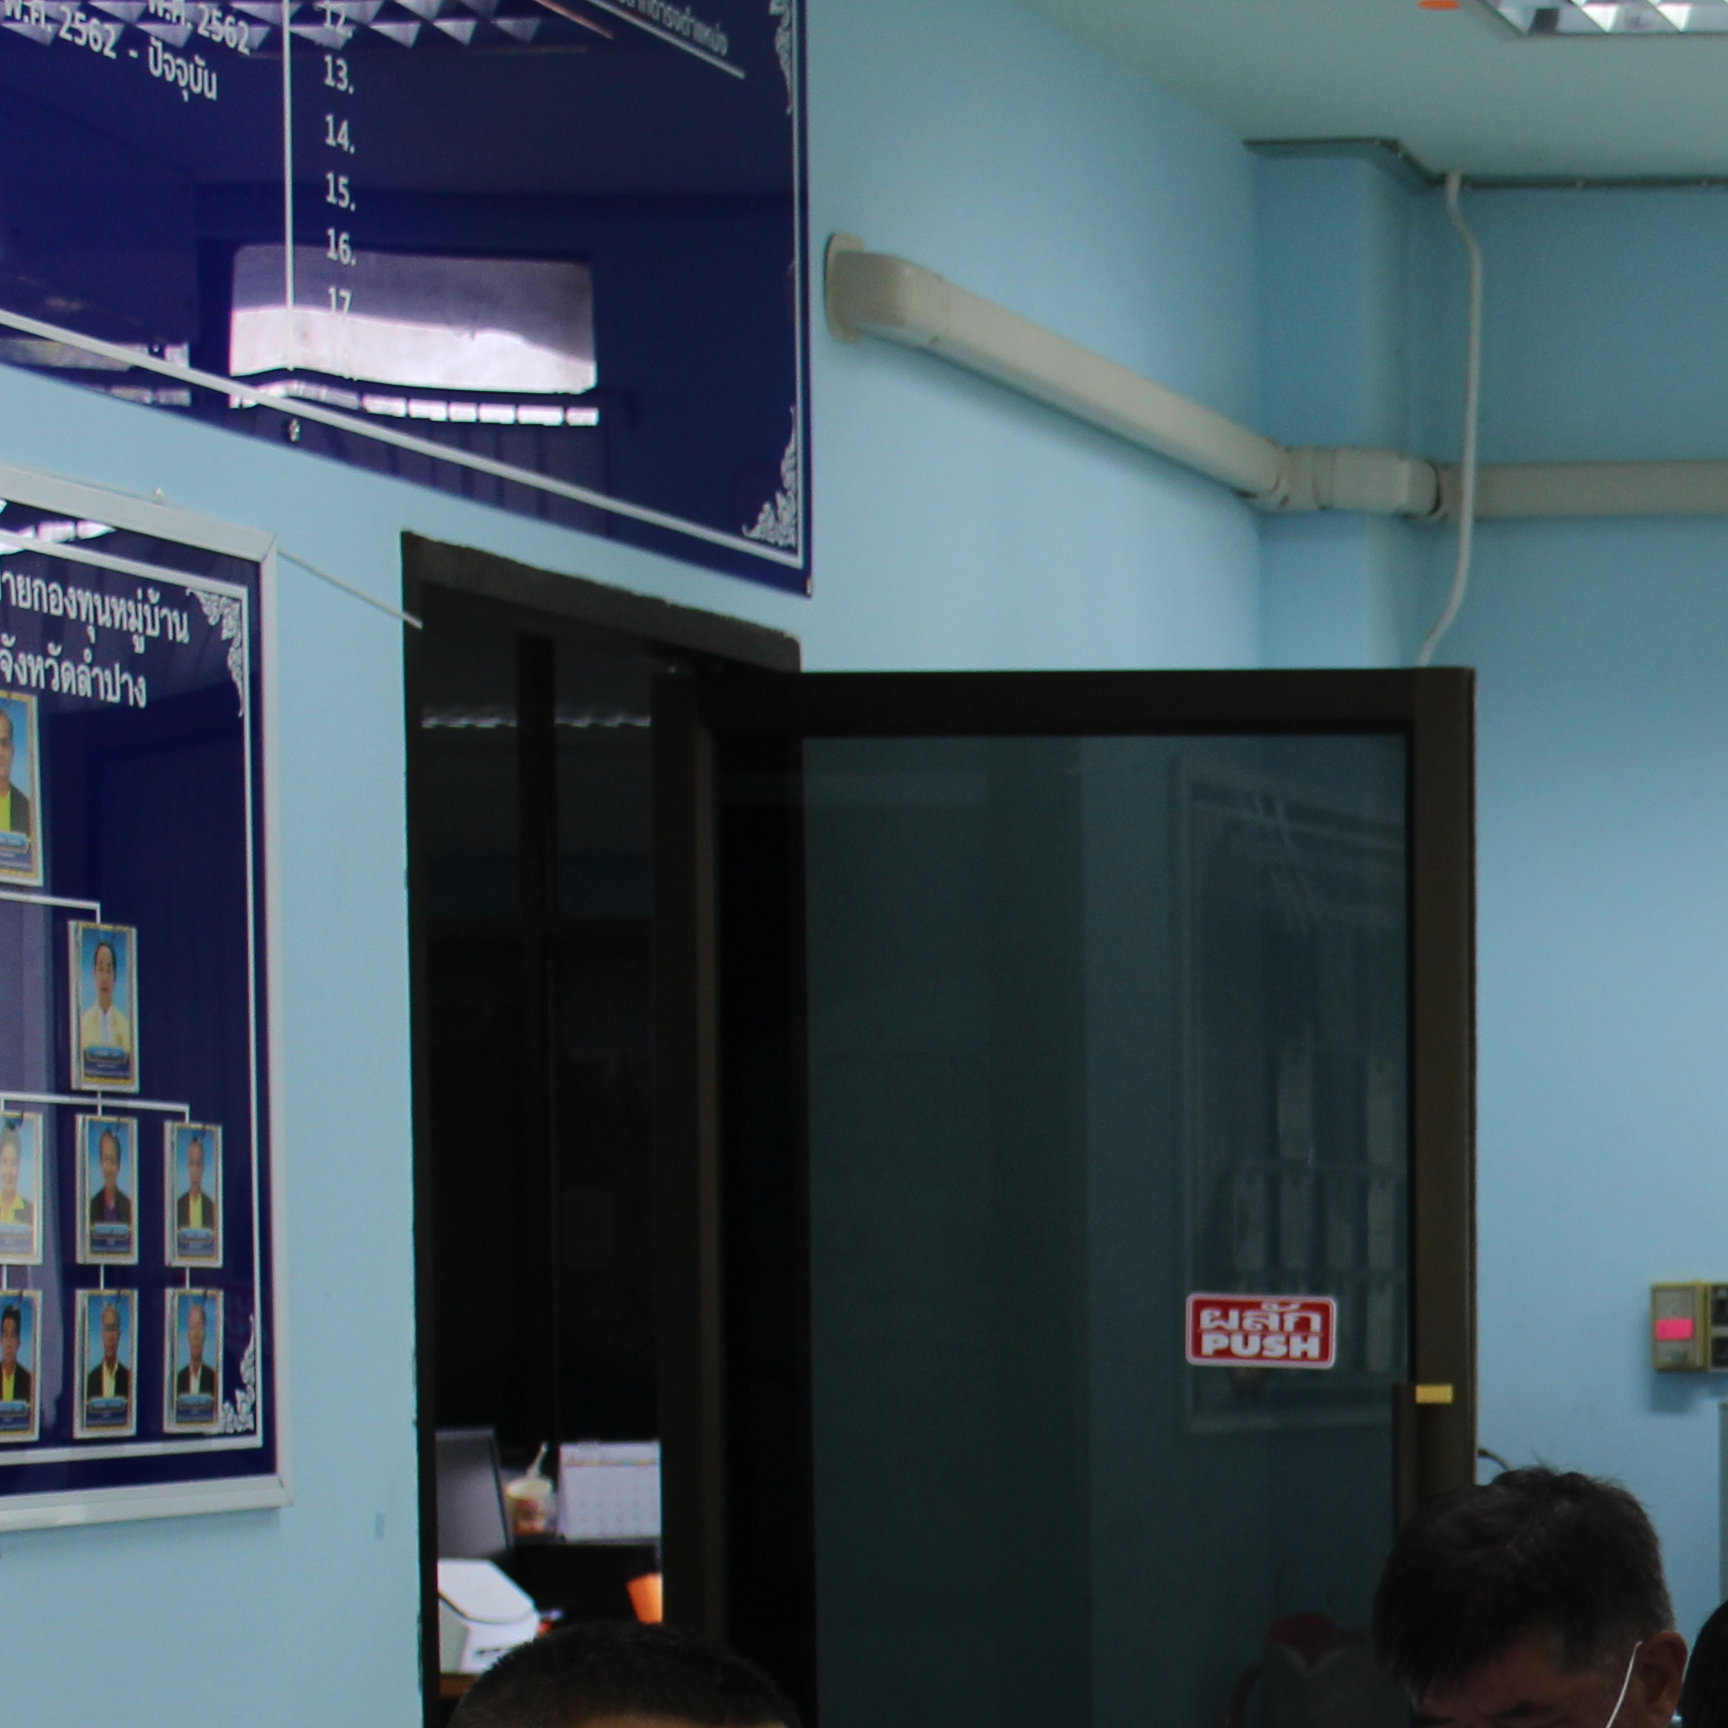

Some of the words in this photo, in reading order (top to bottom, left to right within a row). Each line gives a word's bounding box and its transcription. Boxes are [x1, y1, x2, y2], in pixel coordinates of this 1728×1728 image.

[197, 3, 251, 56] 2562
[58, 5, 117, 59] 2562
[148, 35, 217, 102] ปัจจุบัน
[324, 54, 354, 95] 13.
[325, 114, 355, 154] 14.
[325, 171, 356, 212] 15.
[326, 227, 357, 267] 16.
[0, 632, 147, 708] จังหวัดลำปาง
[1200, 1301, 1322, 1332] ผลัก
[1201, 1333, 1321, 1359] PUSH
